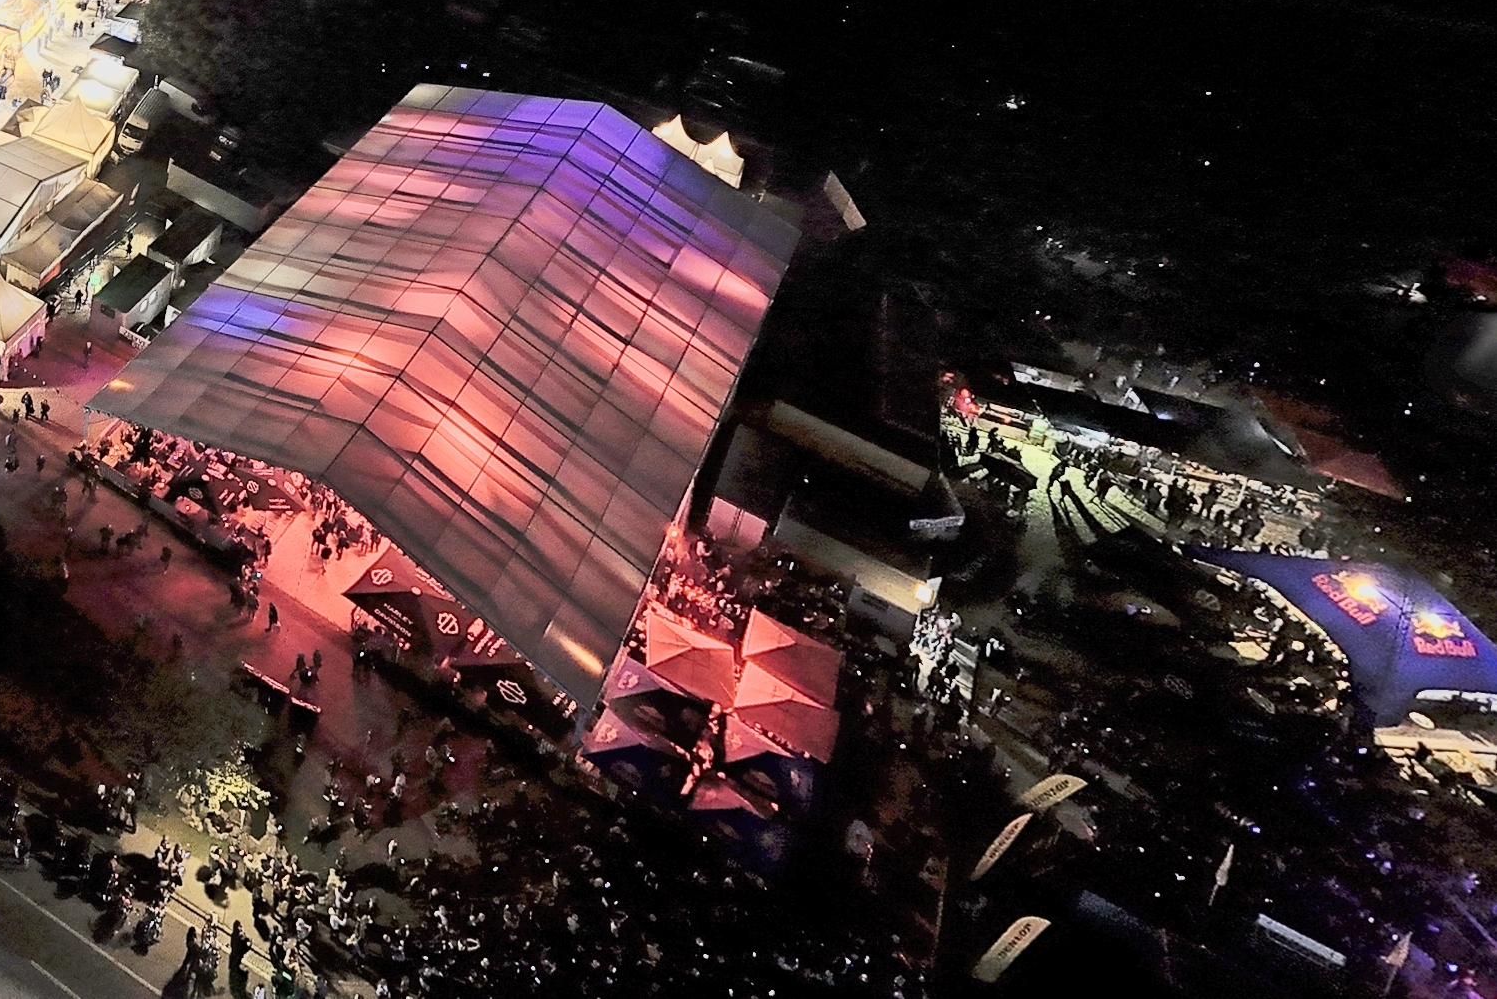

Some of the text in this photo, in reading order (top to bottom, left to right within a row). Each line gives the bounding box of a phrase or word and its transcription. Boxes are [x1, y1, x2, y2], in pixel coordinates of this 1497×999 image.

[1311, 573, 1377, 624] Red Bull
[373, 608, 412, 638] DAVIDSON
[383, 603, 414, 625] HARLEY
[1413, 636, 1478, 658] Red Bull
[998, 922, 1033, 959] DUNLOP
